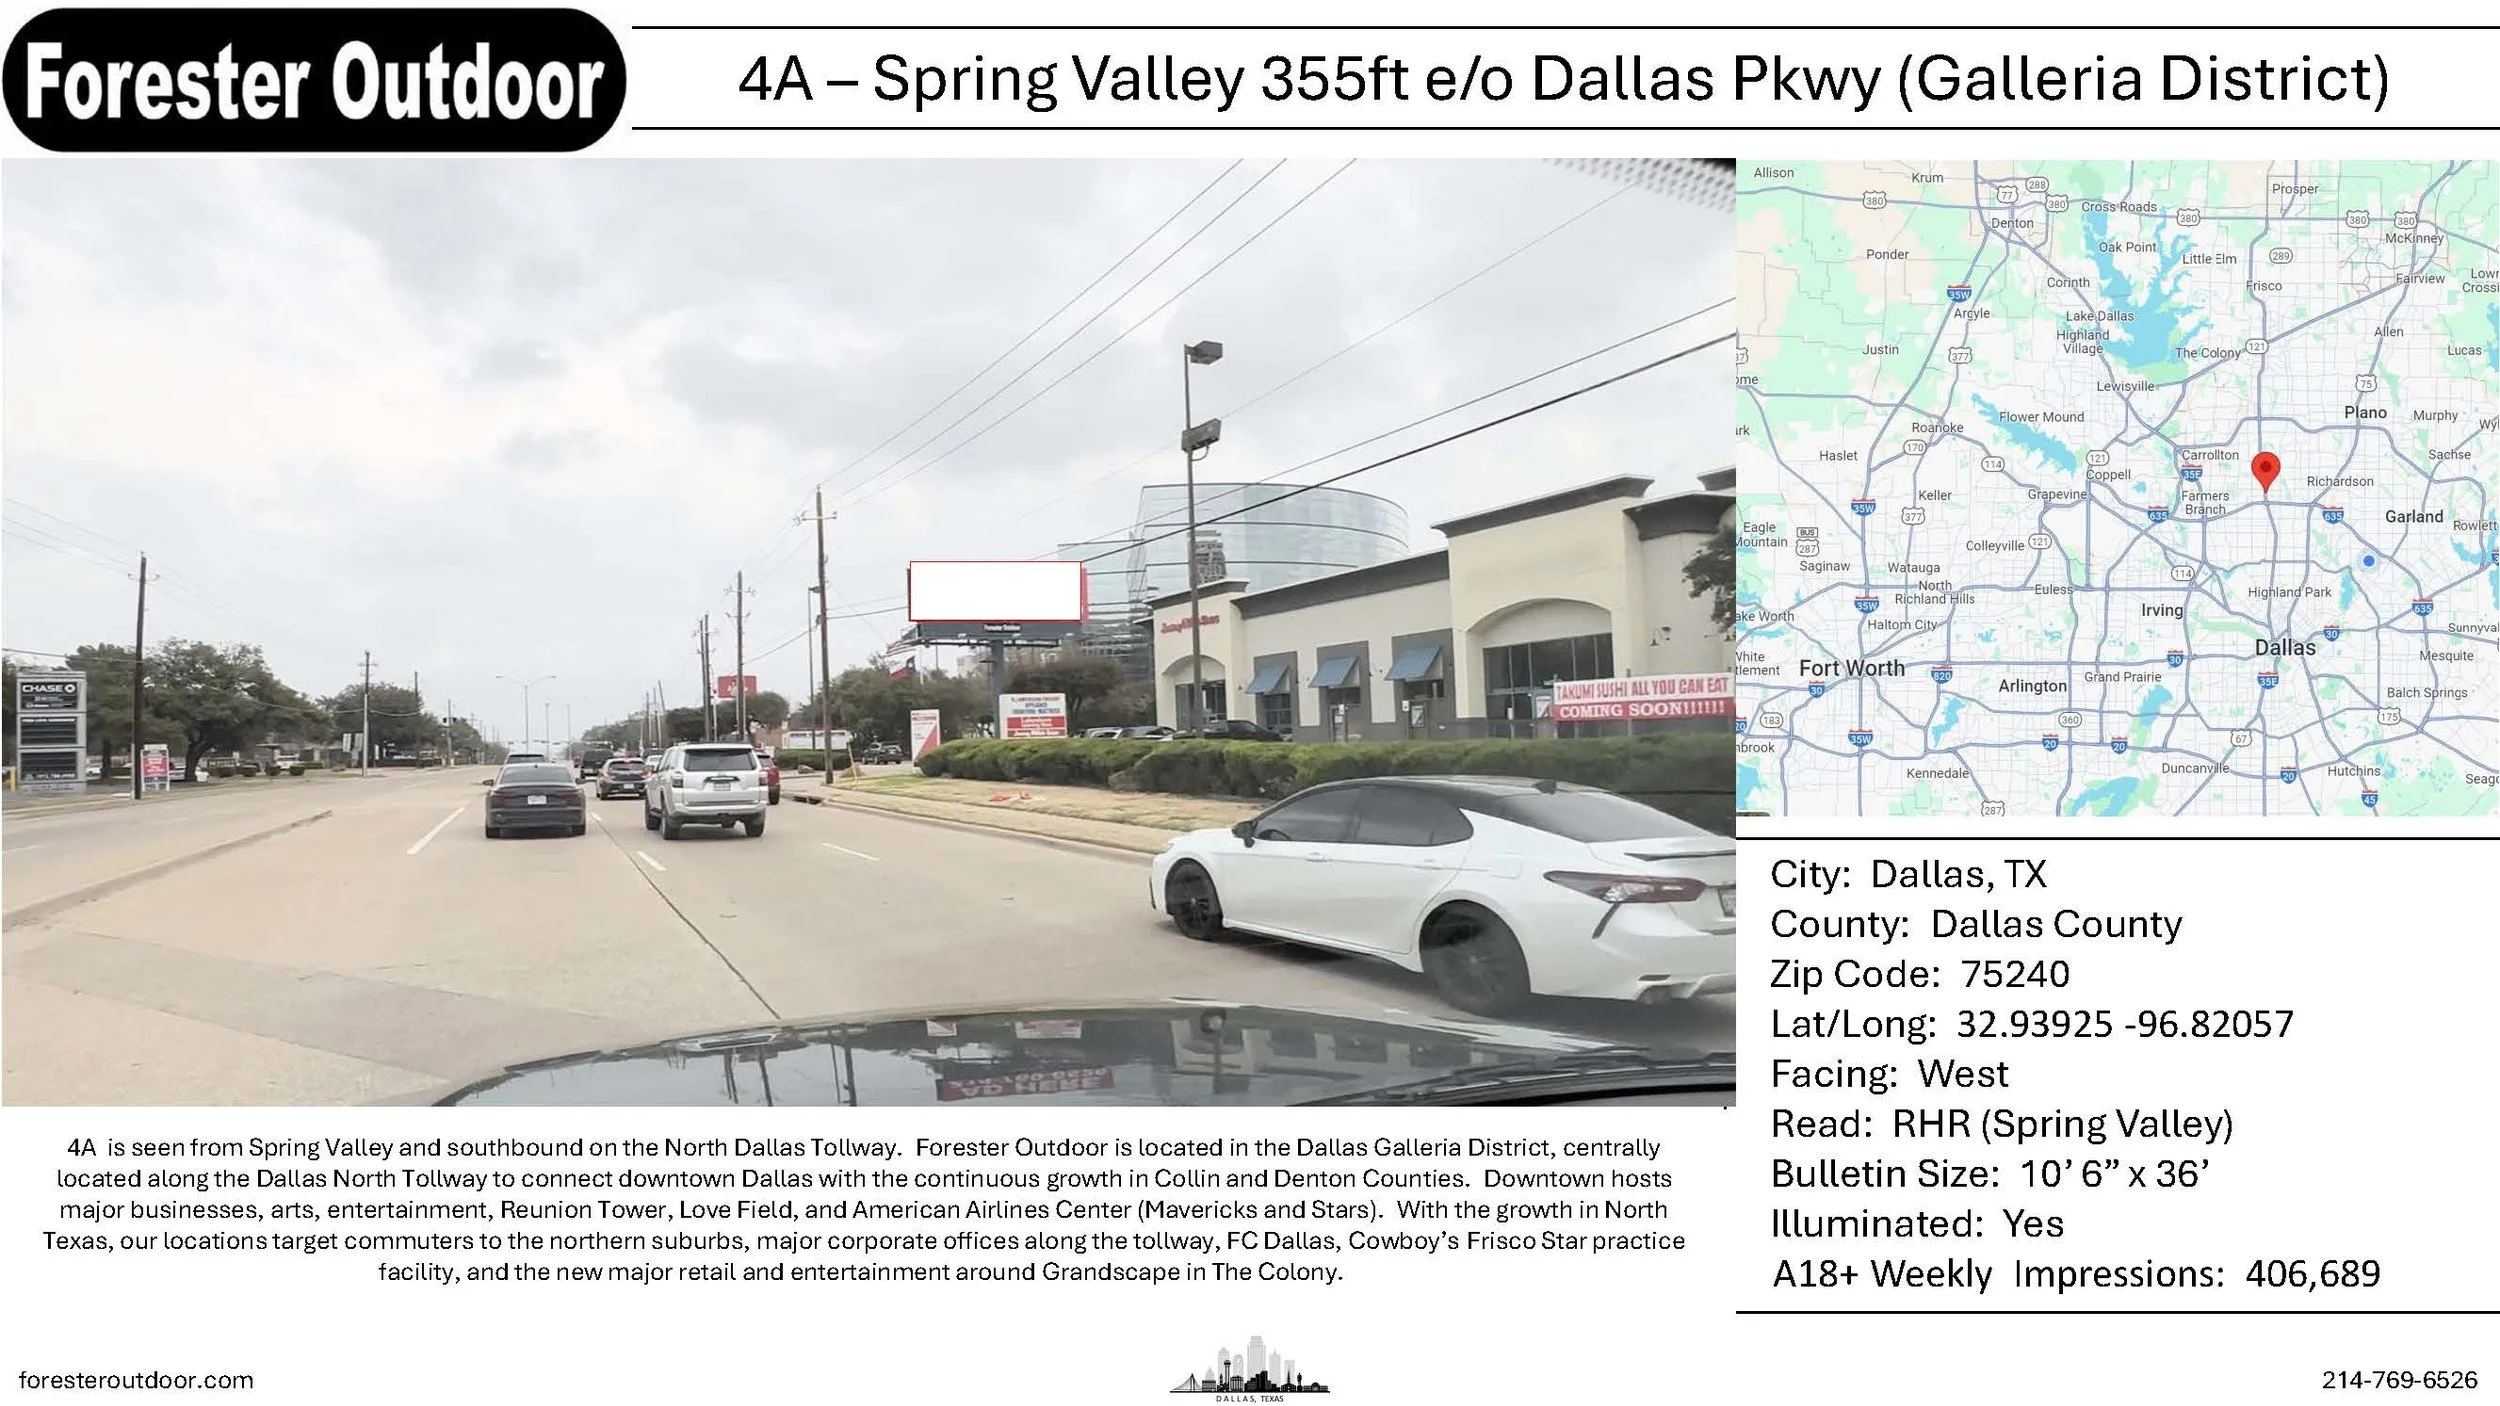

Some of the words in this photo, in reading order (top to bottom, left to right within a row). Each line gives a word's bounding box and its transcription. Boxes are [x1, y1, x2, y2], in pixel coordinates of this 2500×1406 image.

[22, 684, 63, 693] CHASE
[1557, 684, 1594, 701] TAKUMI
[1597, 681, 1628, 697] SUSHI
[1631, 681, 1649, 696] ALL
[1652, 679, 1675, 695] YOU
[1679, 678, 1704, 694] CAN
[1707, 677, 1729, 693] EAT
[1560, 704, 1625, 718] COMING
